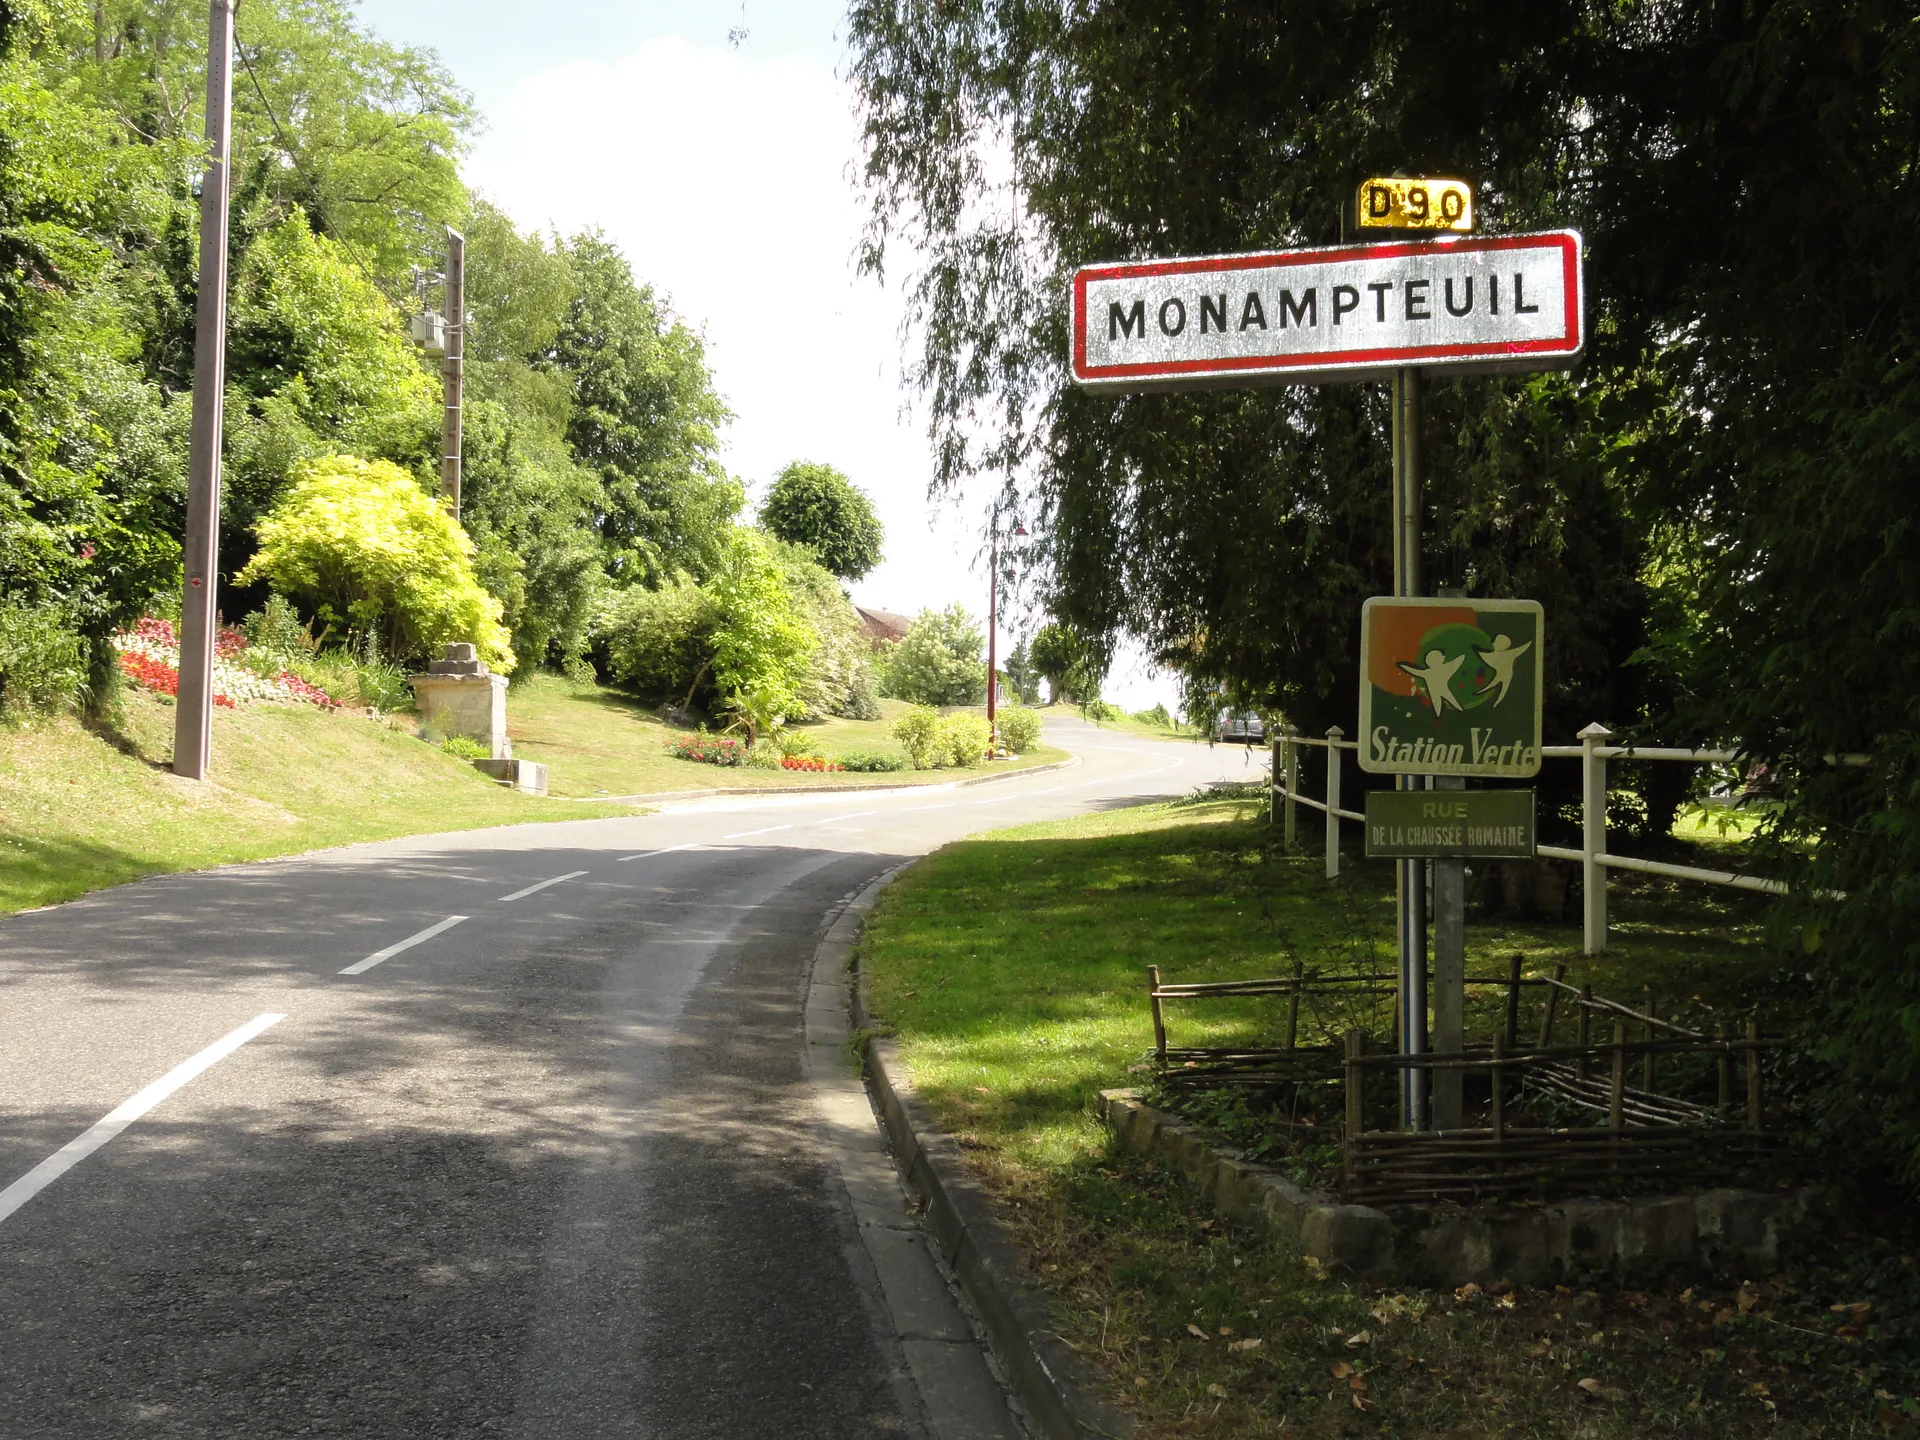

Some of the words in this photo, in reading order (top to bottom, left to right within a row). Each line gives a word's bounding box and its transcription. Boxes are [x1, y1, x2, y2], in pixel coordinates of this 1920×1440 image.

[1108, 272, 1539, 342] MONAMPTEUIL
[1372, 725, 1464, 768] Station
[1470, 727, 1537, 771] Verte
[1423, 802, 1468, 818] RUE
[1372, 826, 1386, 846] DE
[1390, 826, 1403, 846] LA
[1468, 827, 1525, 846] ROMAINE
